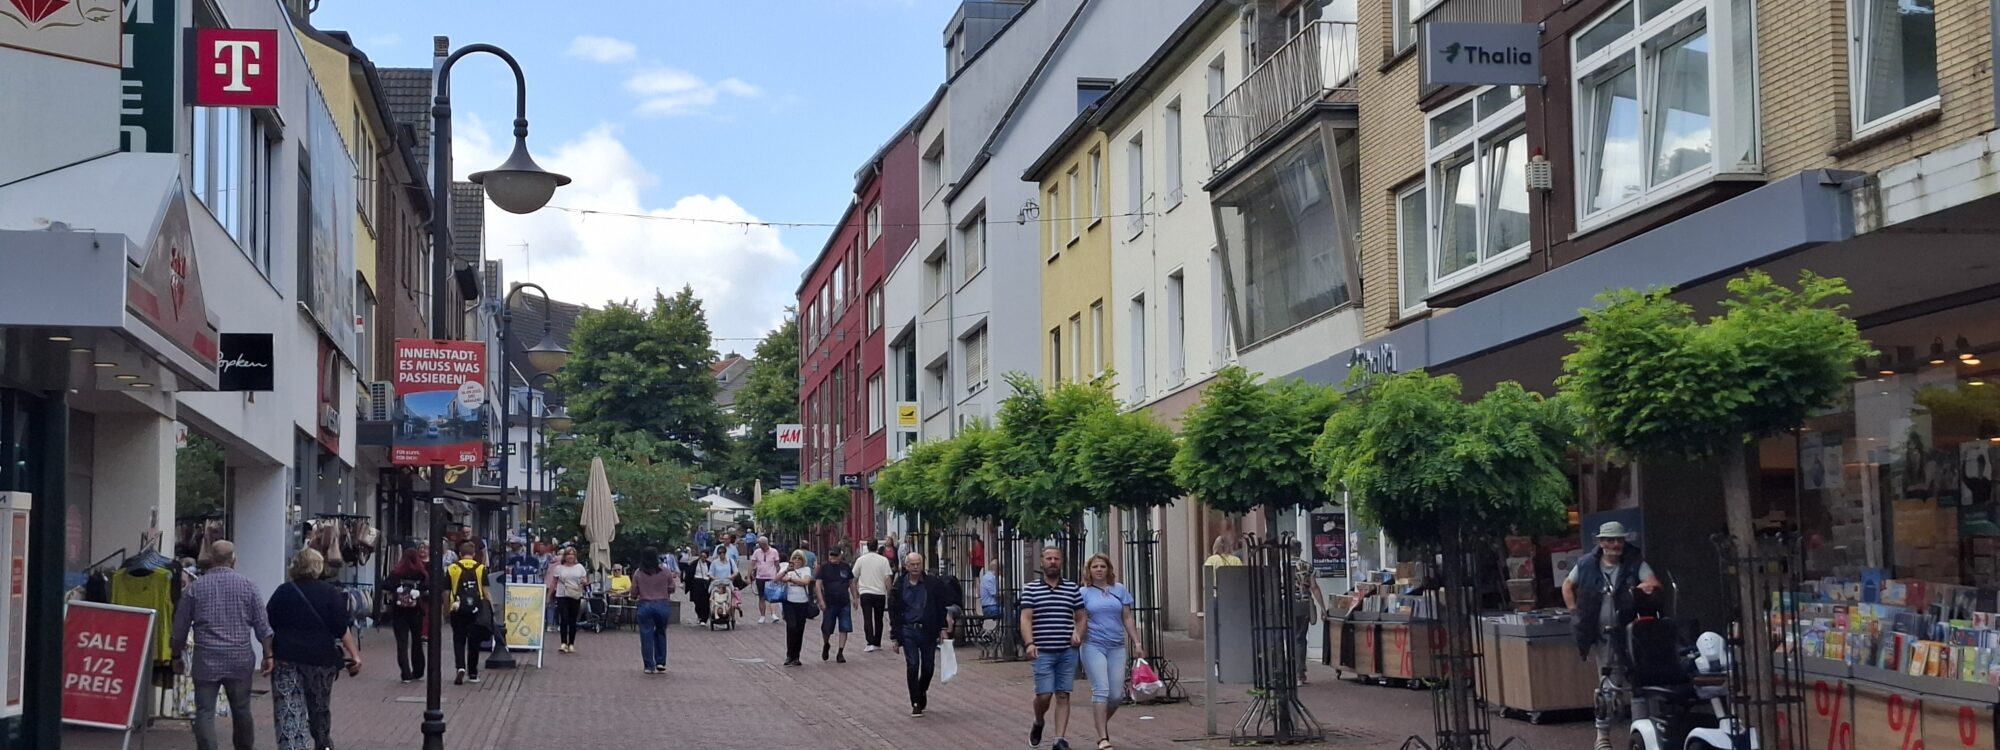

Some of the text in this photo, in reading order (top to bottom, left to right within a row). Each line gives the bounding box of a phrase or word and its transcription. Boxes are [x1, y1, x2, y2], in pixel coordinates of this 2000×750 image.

[1463, 45, 1532, 65] Thalia
[214, 40, 260, 92] T
[400, 347, 478, 362] INNENSTADT:
[399, 360, 480, 374] ES MUSS WAS
[399, 372, 467, 385] PASSIEREN!
[779, 428, 801, 444] H&M
[459, 454, 476, 462] SPD
[77, 631, 128, 652] SALE
[83, 656, 115, 674] 1/2
[64, 673, 123, 694] PREIS
